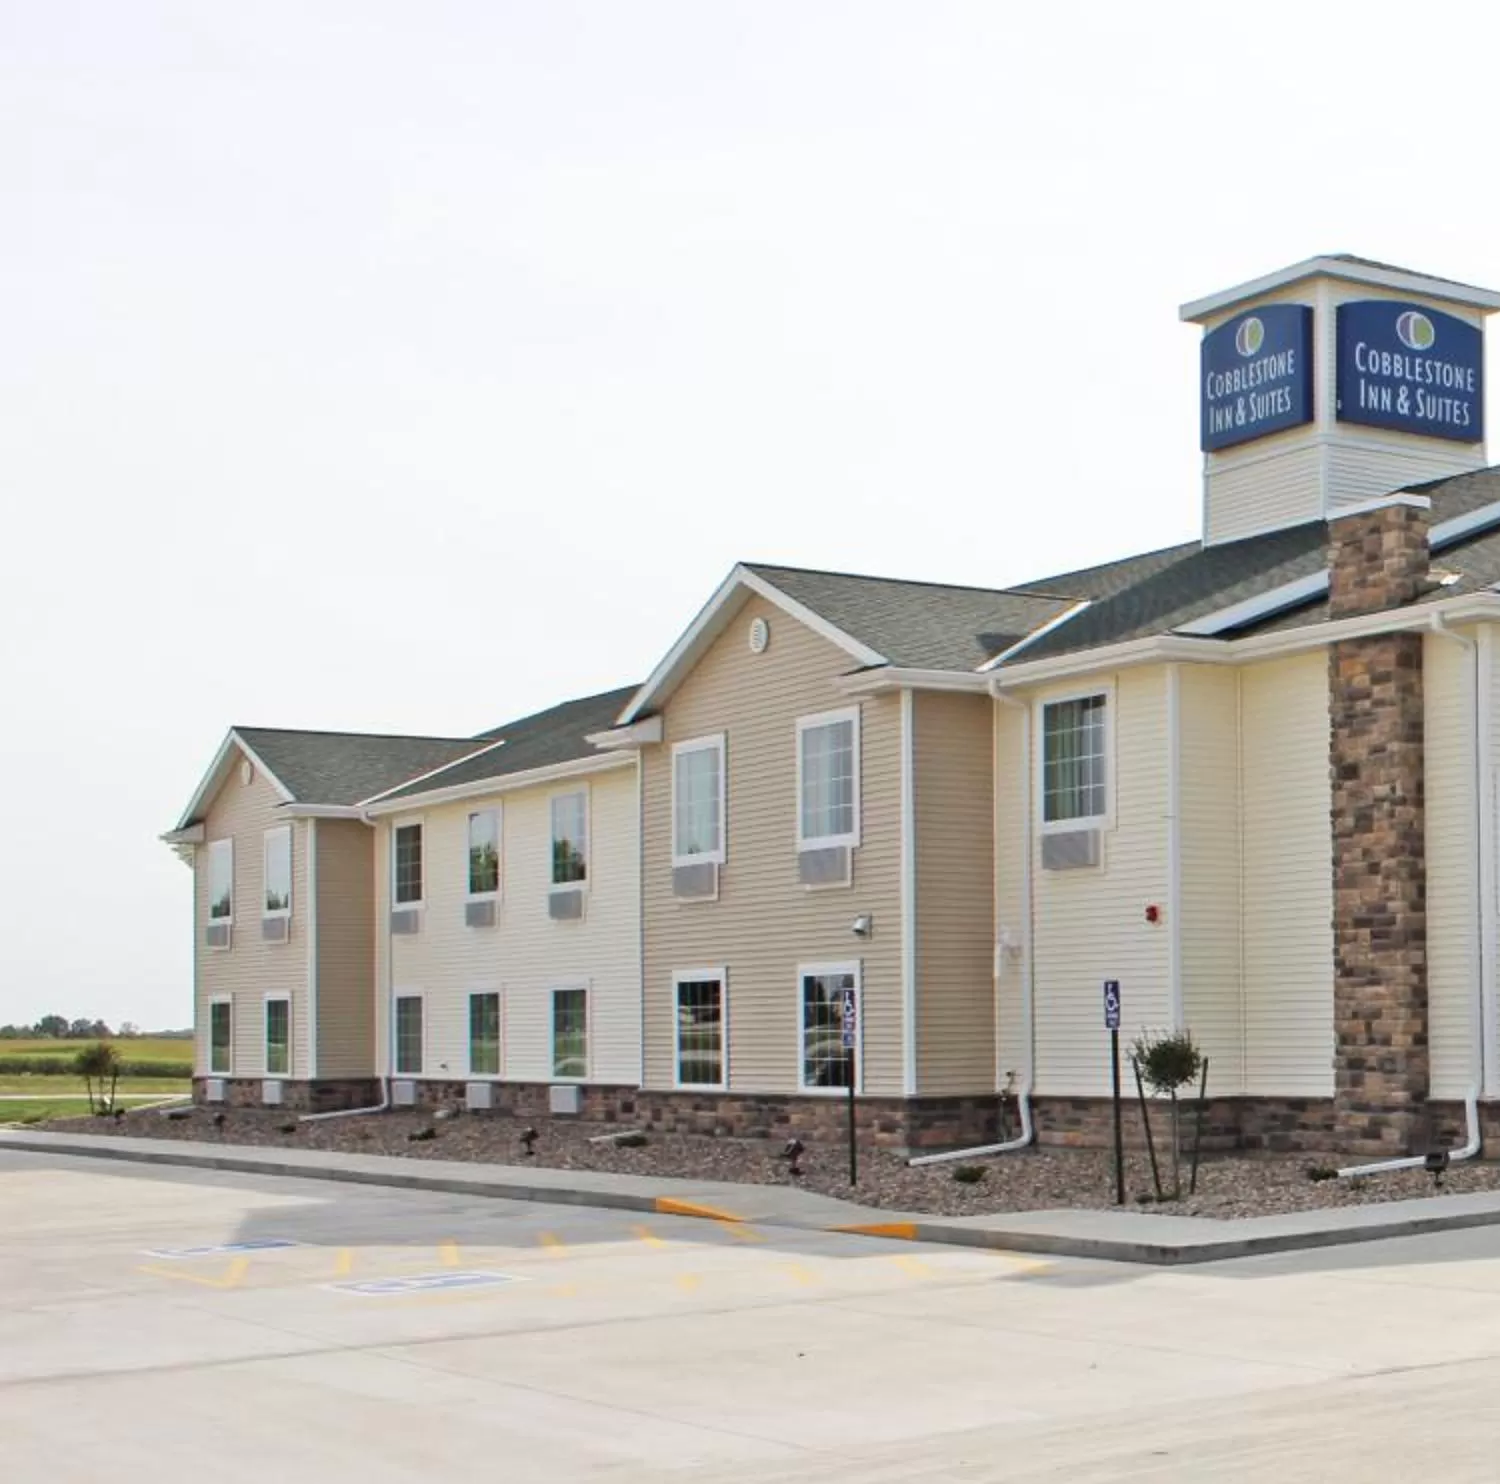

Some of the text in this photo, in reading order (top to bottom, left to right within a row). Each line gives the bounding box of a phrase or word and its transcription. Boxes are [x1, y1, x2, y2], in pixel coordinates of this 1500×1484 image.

[1207, 350, 1295, 399] COBBLESTONE
[1355, 342, 1475, 392] COBBLESTONE
[1209, 387, 1292, 434] INN & SUITES
[1360, 379, 1470, 427] INN & SUITES
